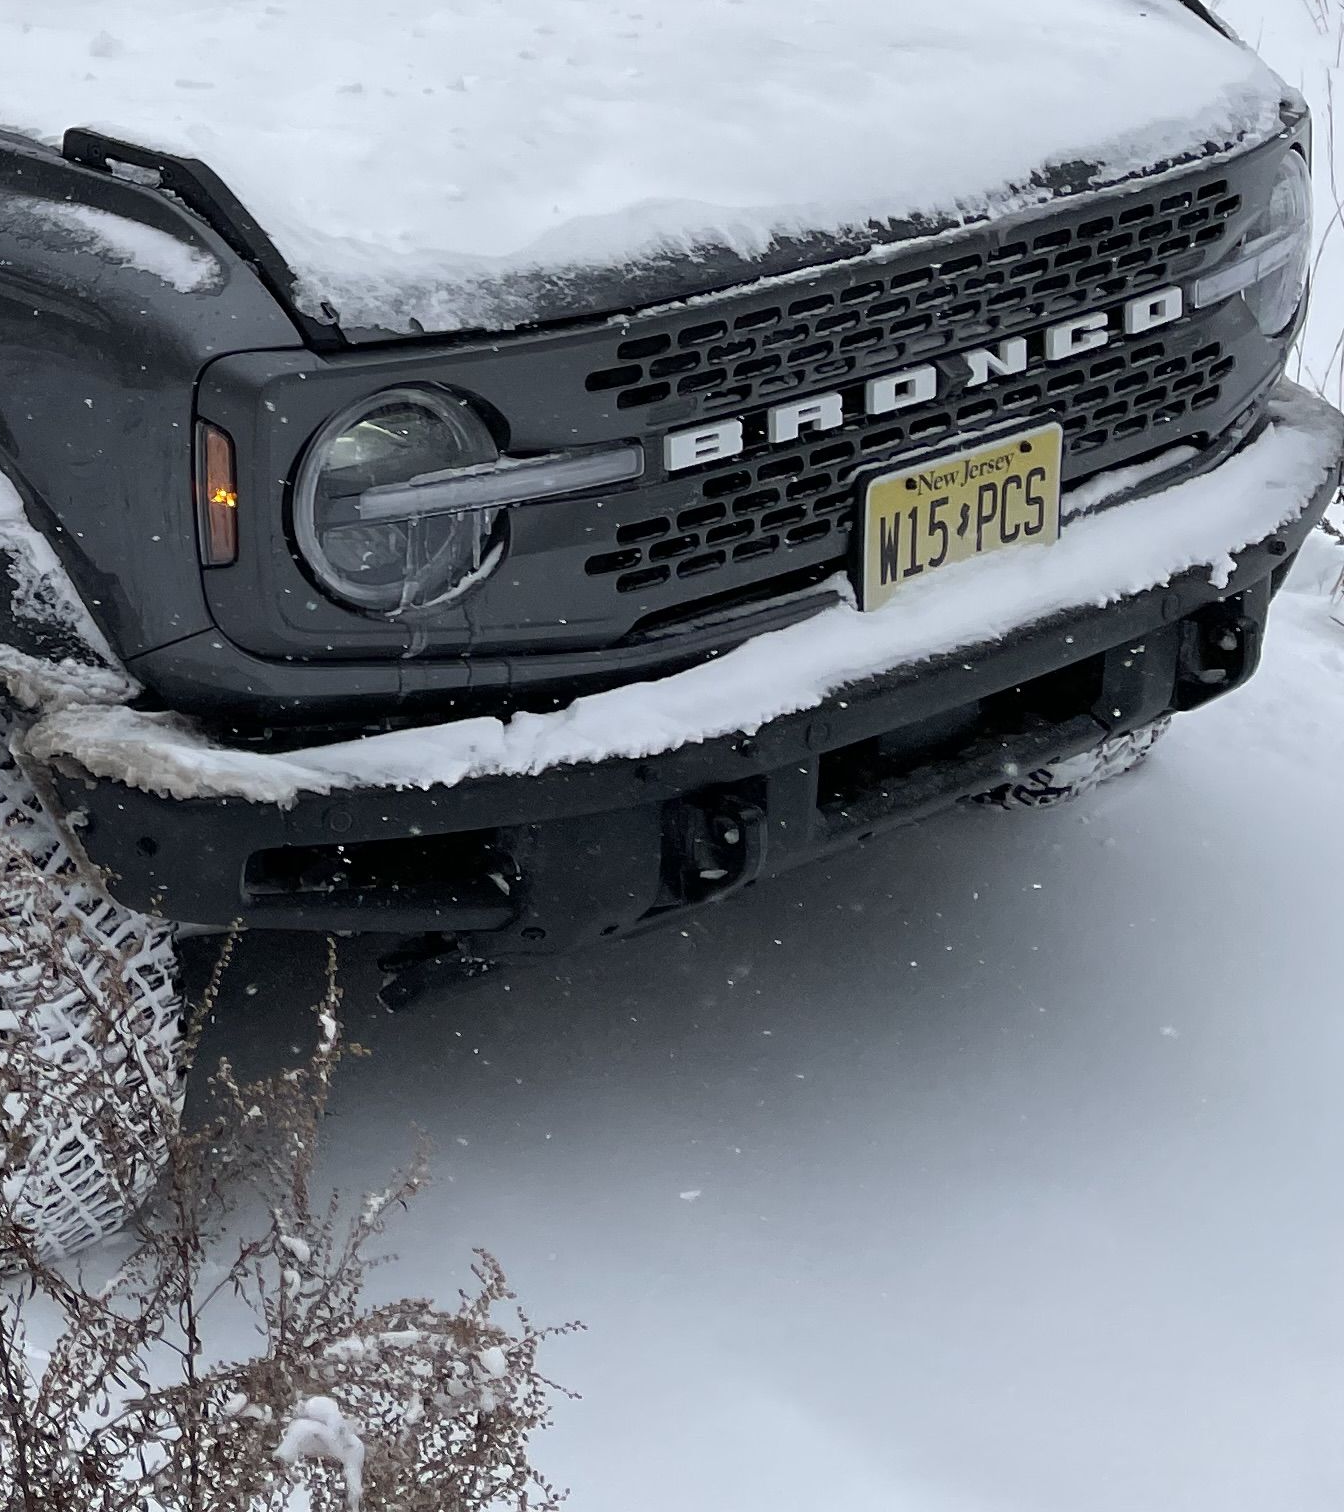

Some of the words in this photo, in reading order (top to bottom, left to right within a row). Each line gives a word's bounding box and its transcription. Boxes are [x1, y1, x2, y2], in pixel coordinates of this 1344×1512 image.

[664, 286, 1183, 472] BRONCO
[916, 470, 960, 496] New
[961, 452, 1015, 487] Jersey
